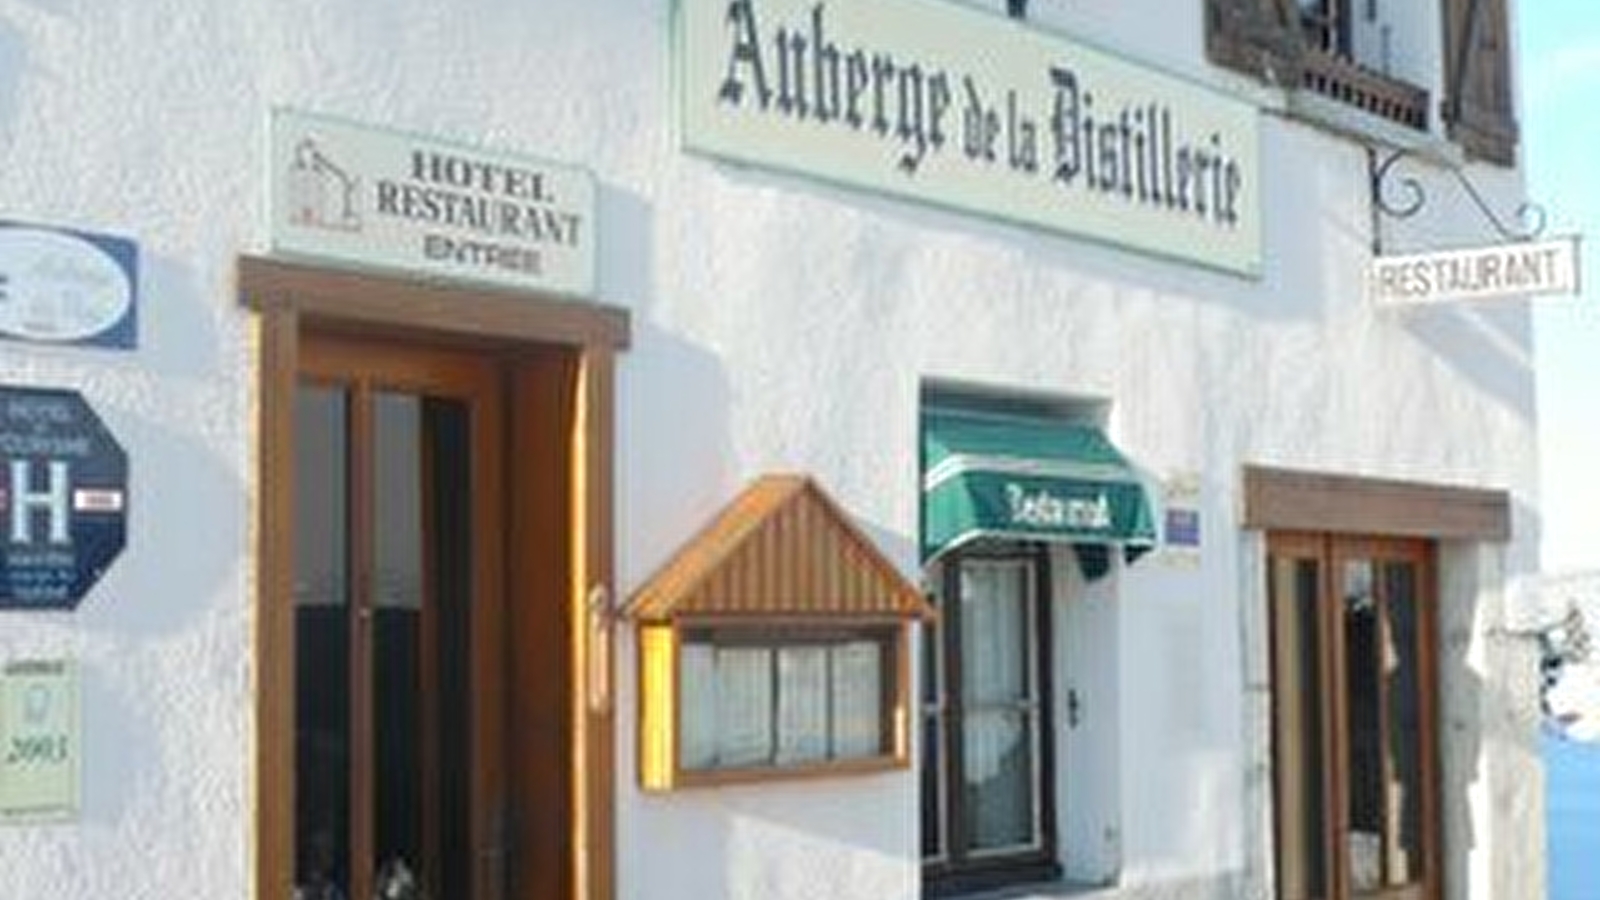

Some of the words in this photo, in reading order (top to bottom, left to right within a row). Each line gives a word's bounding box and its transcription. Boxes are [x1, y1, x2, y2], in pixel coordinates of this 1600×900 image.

[718, 0, 951, 175] Auberge
[963, 74, 1000, 162] de
[1008, 90, 1037, 173] la
[1049, 66, 1242, 227] Distillerie
[410, 150, 556, 202] HOTEL
[376, 180, 582, 247] RESTAURANT
[1379, 249, 1561, 297] RESTAURANT
[10, 459, 70, 544] H
